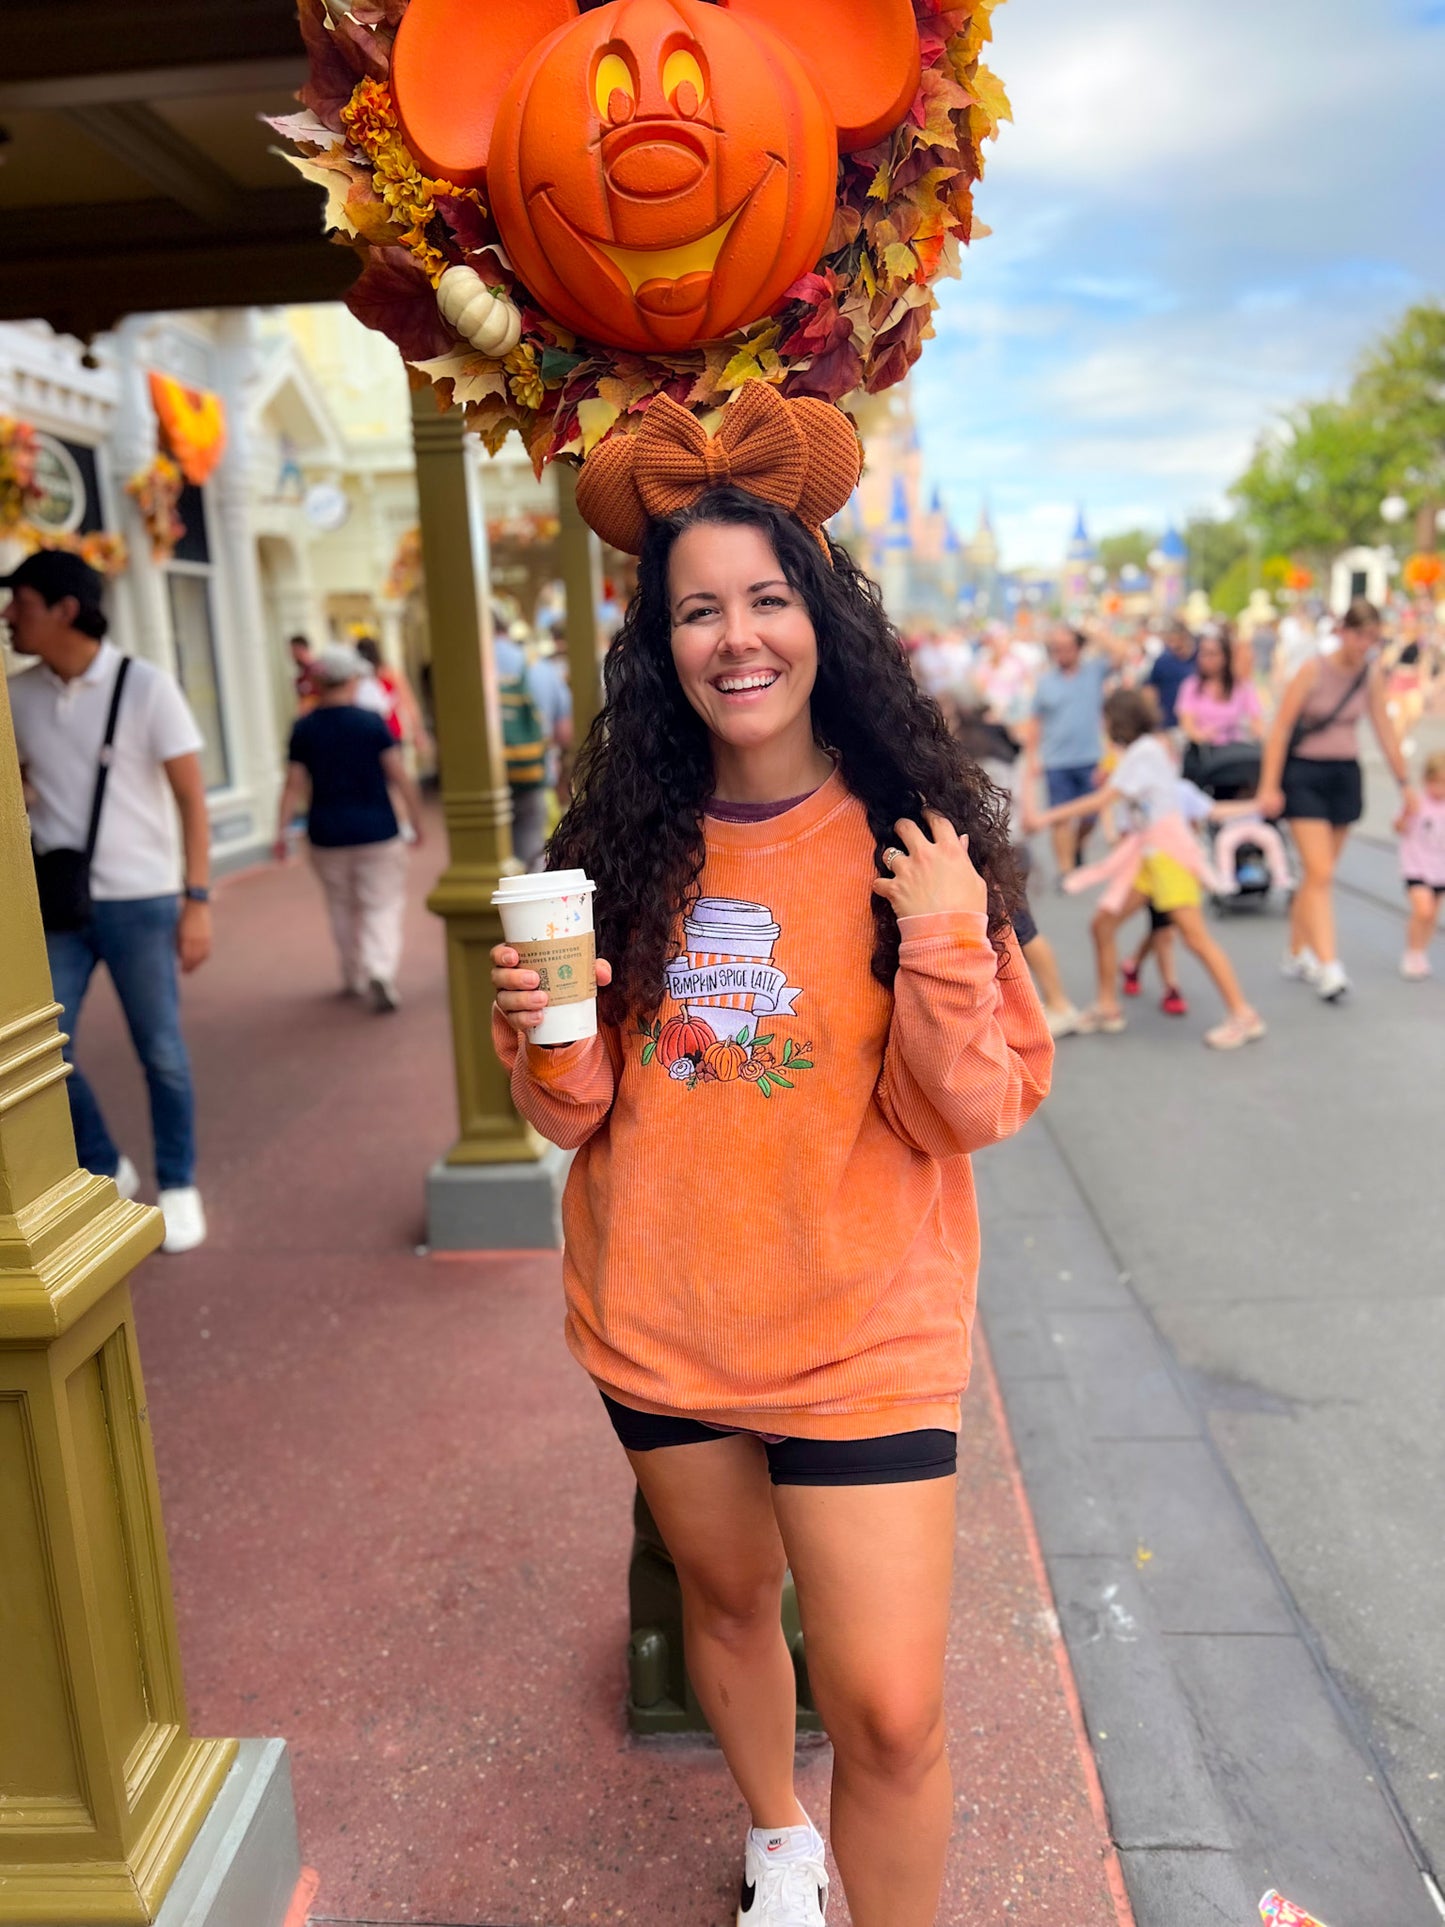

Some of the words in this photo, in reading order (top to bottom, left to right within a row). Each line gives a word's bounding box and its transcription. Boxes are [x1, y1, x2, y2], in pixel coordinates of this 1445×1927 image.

[552, 946, 580, 955] EVERYONE
[563, 952, 582, 960] COFFEE
[673, 971, 717, 995] PUMPKIN
[718, 968, 748, 988] SPICE
[751, 969, 780, 994] LATTE
